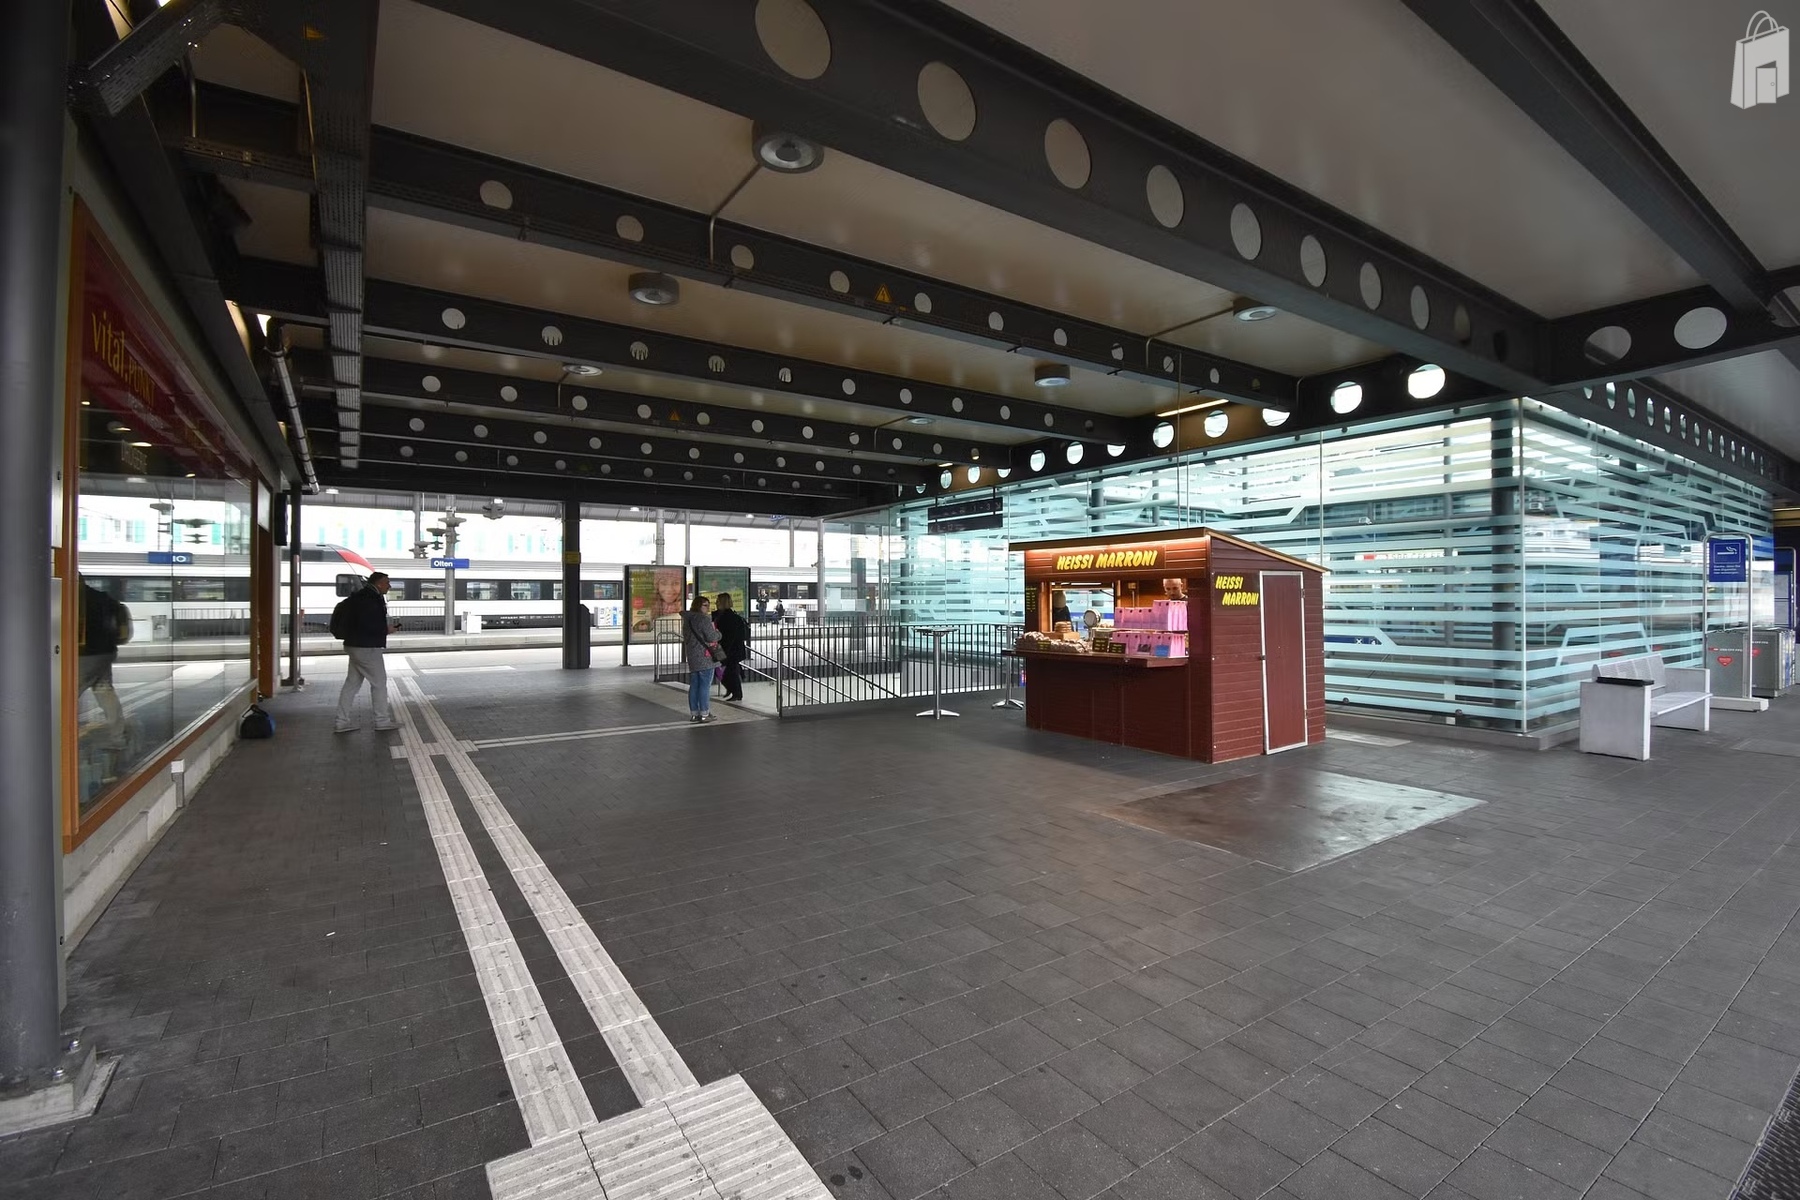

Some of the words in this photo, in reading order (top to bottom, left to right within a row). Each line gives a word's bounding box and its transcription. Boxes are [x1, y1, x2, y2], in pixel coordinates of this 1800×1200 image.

[1056, 554, 1093, 570] HEISSI
[1095, 550, 1158, 569] MARRONI
[1215, 575, 1244, 590] HEISSI
[1222, 591, 1260, 607] MARRONI
